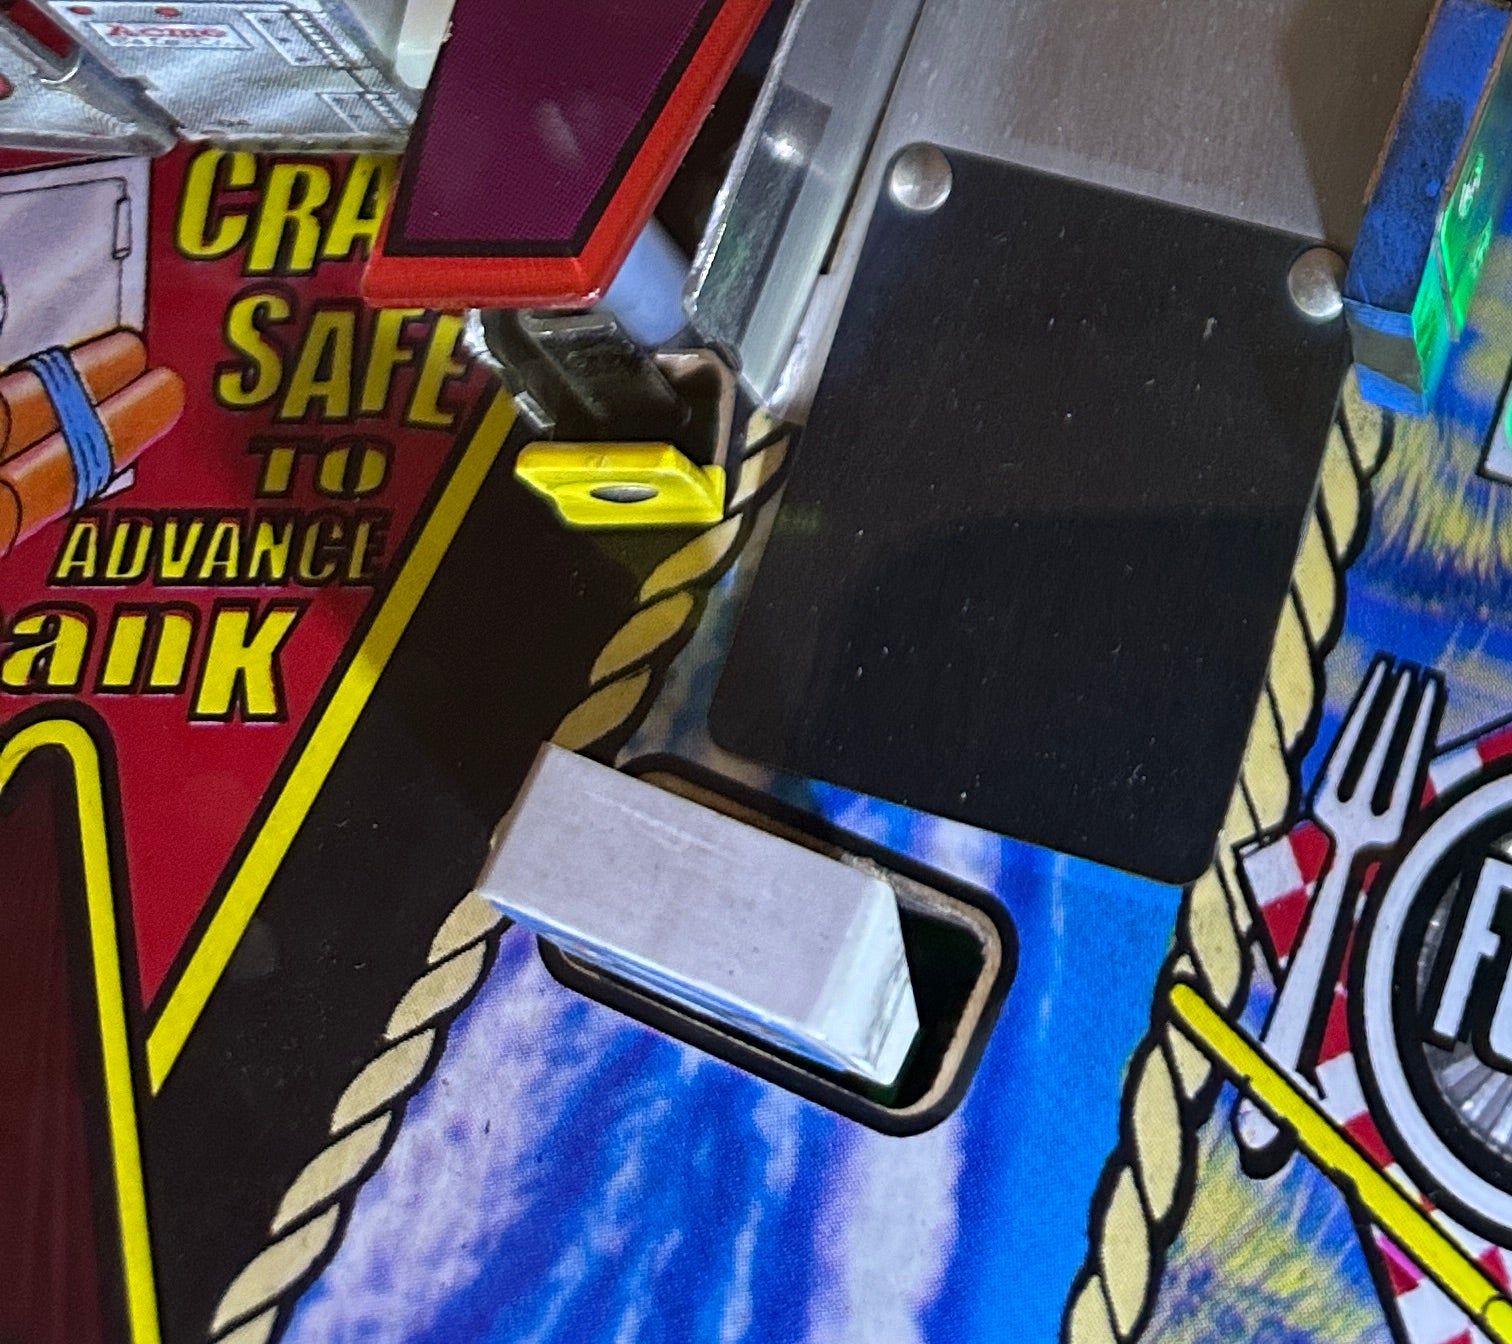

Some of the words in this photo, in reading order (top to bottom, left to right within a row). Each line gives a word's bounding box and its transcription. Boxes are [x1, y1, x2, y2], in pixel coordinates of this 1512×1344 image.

[174, 146, 400, 275] CRA
[215, 291, 468, 427] SAFE
[250, 441, 391, 496] TO
[53, 515, 387, 582] ADVANCE
[0, 604, 300, 717] anK
